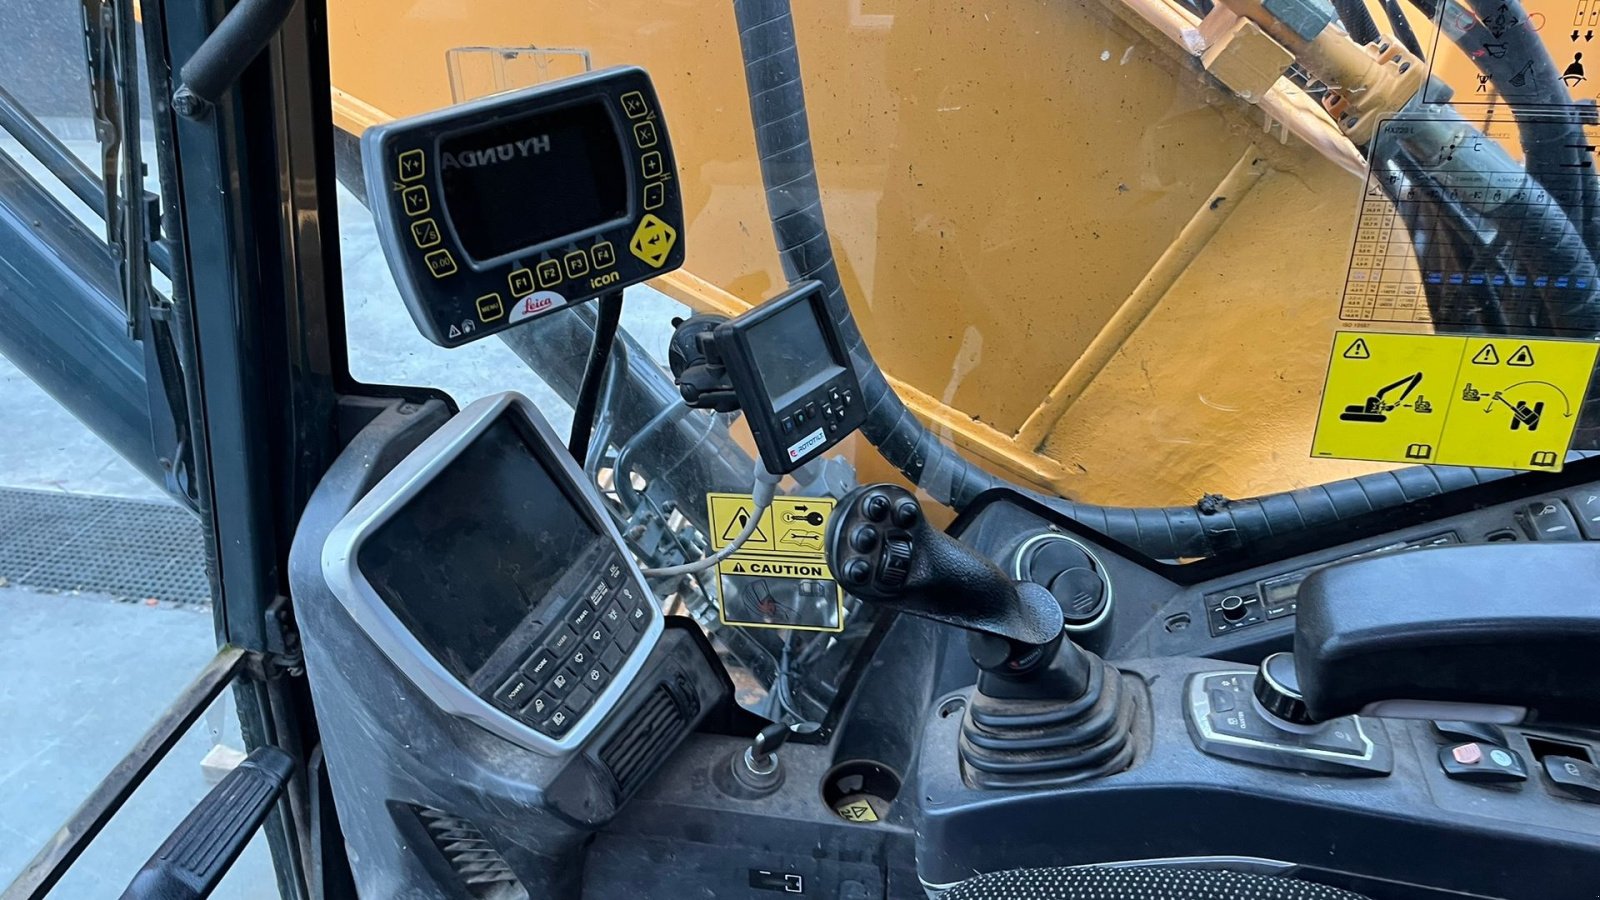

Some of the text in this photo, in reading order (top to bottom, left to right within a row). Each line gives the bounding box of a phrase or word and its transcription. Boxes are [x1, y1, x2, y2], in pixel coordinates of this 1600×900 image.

[627, 100, 640, 111] X+
[403, 160, 419, 171] Y+
[597, 250, 609, 261] F4
[432, 257, 451, 270] 0.00
[570, 258, 583, 270] F3
[543, 268, 556, 280] F2
[515, 277, 527, 289] F1
[481, 303, 499, 313] MENU
[522, 297, 552, 315] Leica
[798, 432, 824, 452] ROTOTILT
[750, 563, 823, 577] CAUTION
[575, 609, 589, 625] TRAVEL
[534, 658, 548, 673] WORK
[508, 682, 525, 700] POWER
